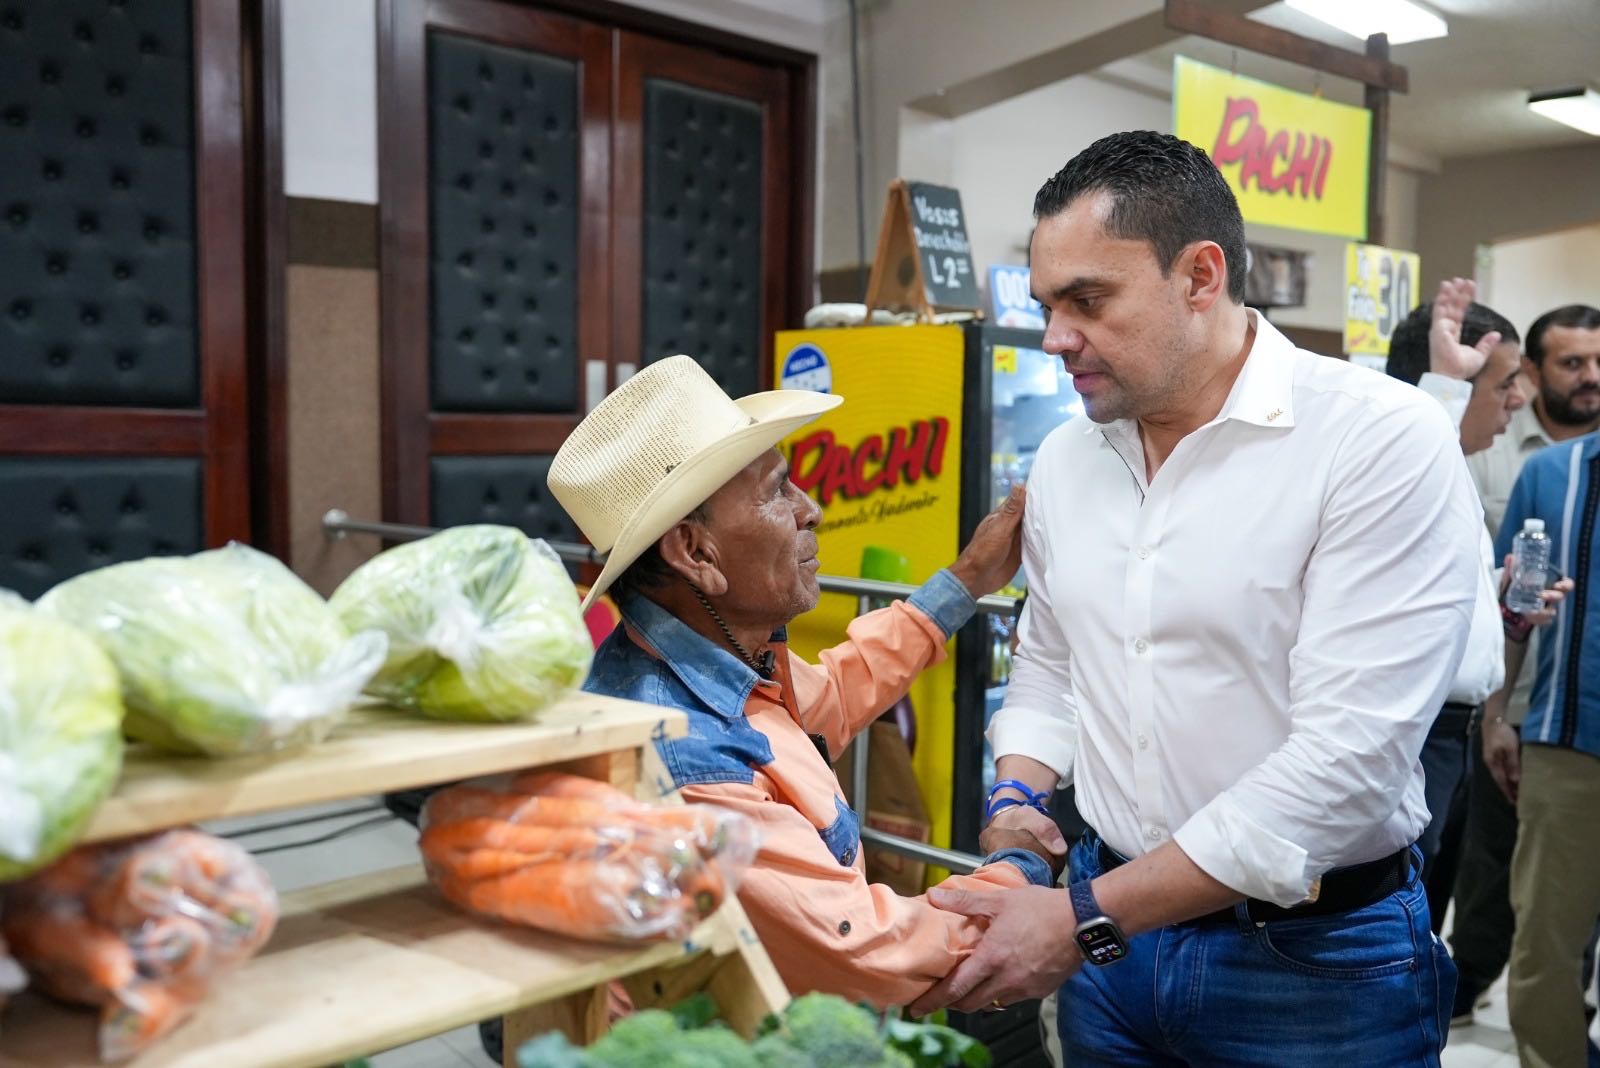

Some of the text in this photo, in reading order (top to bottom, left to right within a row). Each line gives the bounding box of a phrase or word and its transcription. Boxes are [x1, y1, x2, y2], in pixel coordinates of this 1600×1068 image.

[1211, 96, 1333, 203] PACHI
[1377, 254, 1411, 337] 30
[789, 416, 949, 507] PACHI
